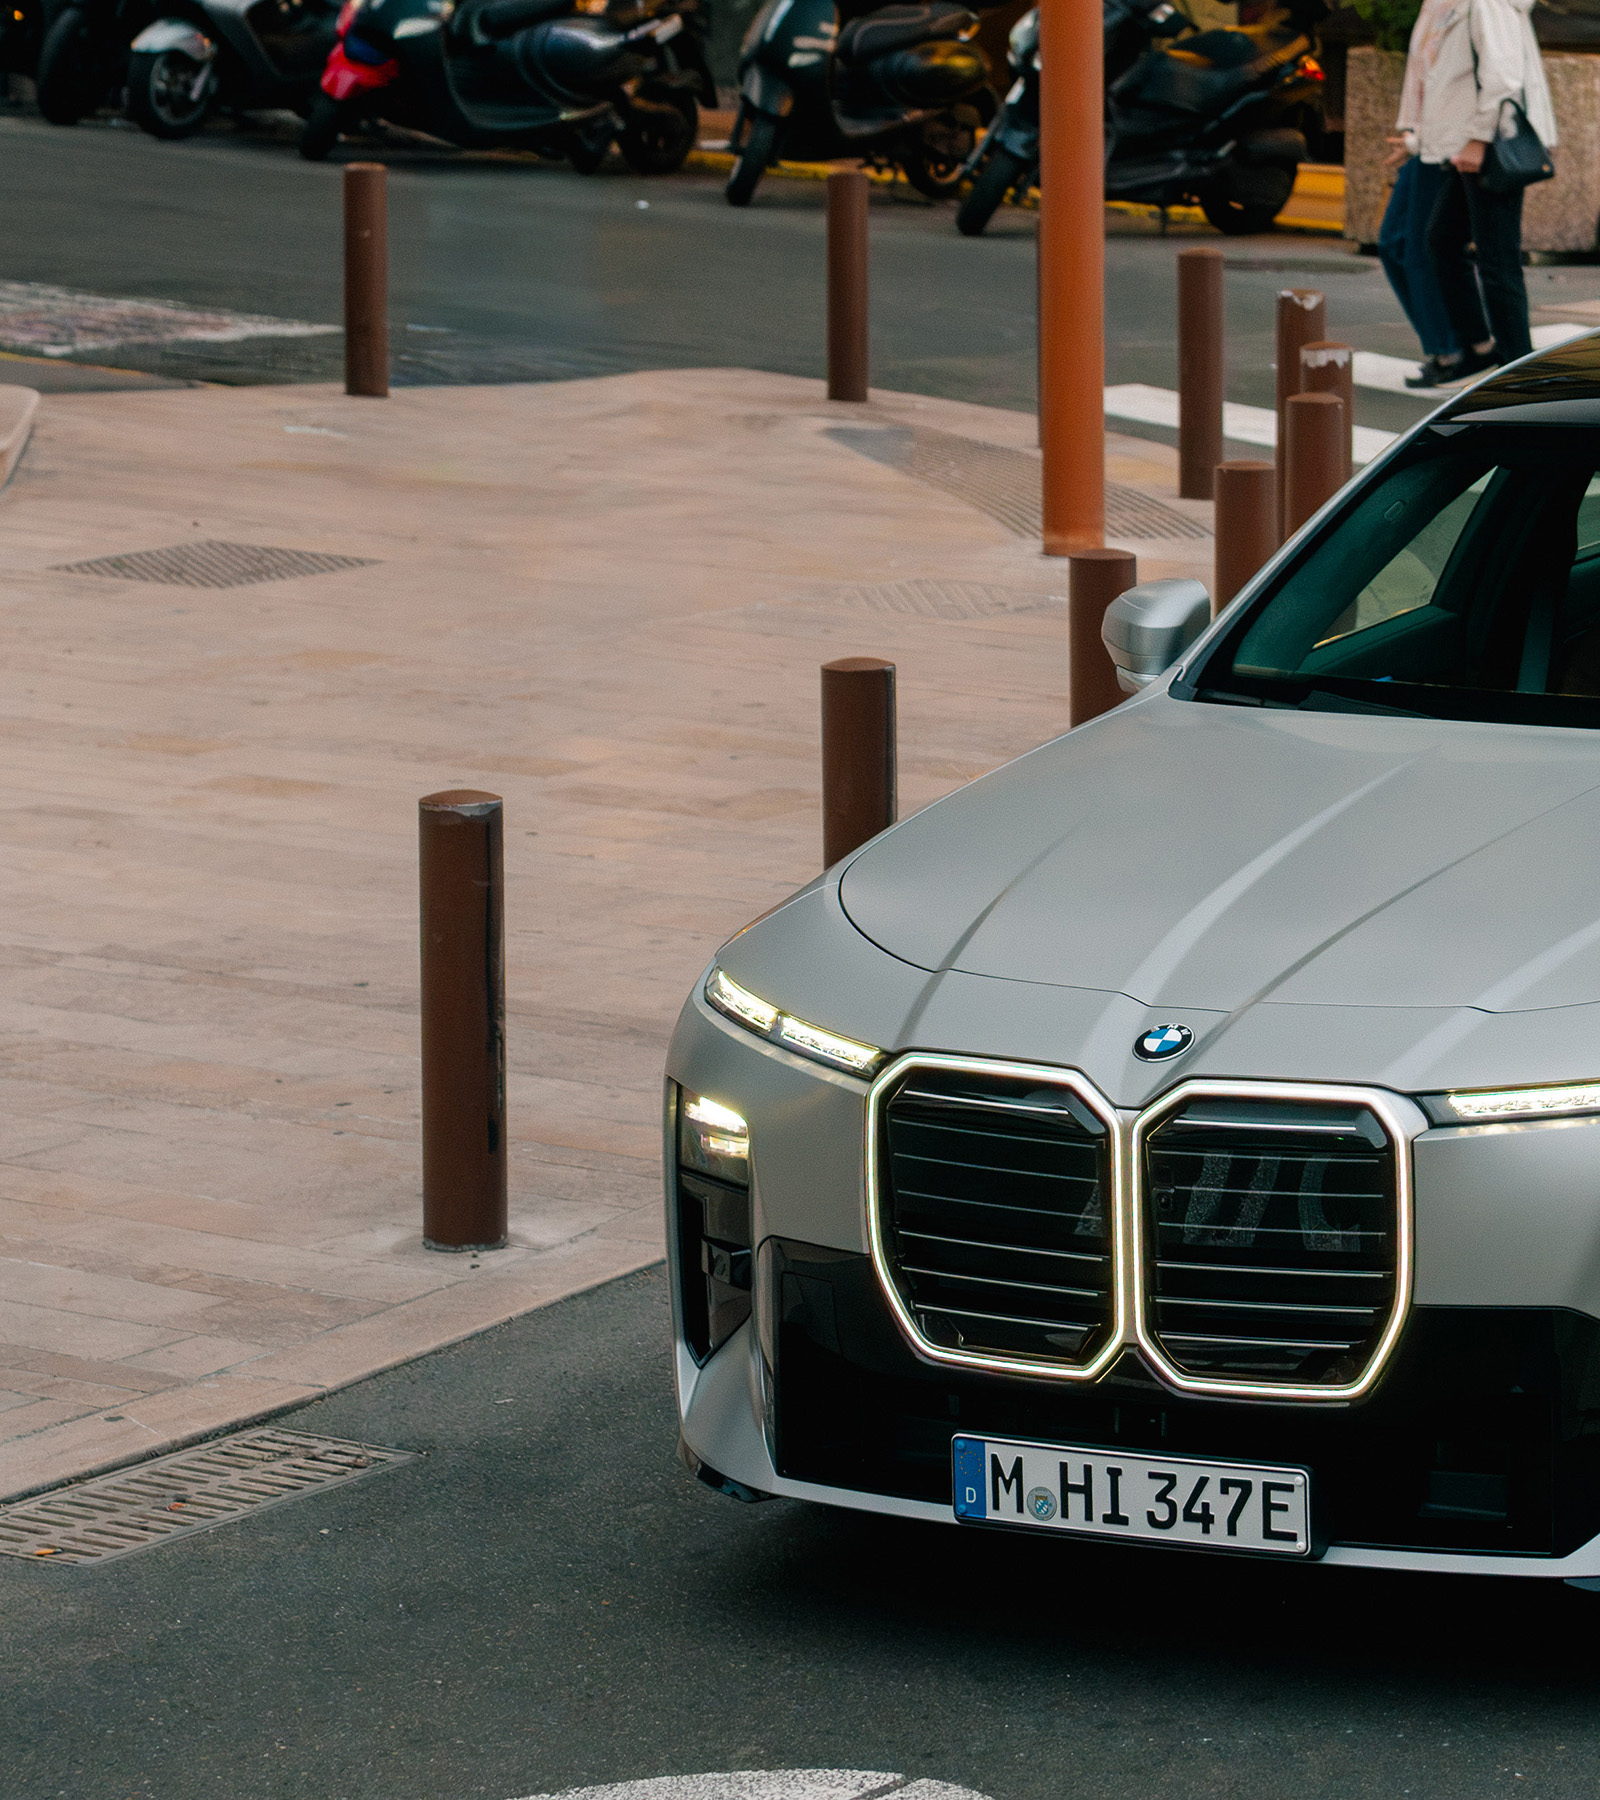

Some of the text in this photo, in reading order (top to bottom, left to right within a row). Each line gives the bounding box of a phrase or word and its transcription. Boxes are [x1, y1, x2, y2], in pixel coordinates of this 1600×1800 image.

[966, 1487, 977, 1504] D
[991, 1453, 1298, 1542] M HI 347E
